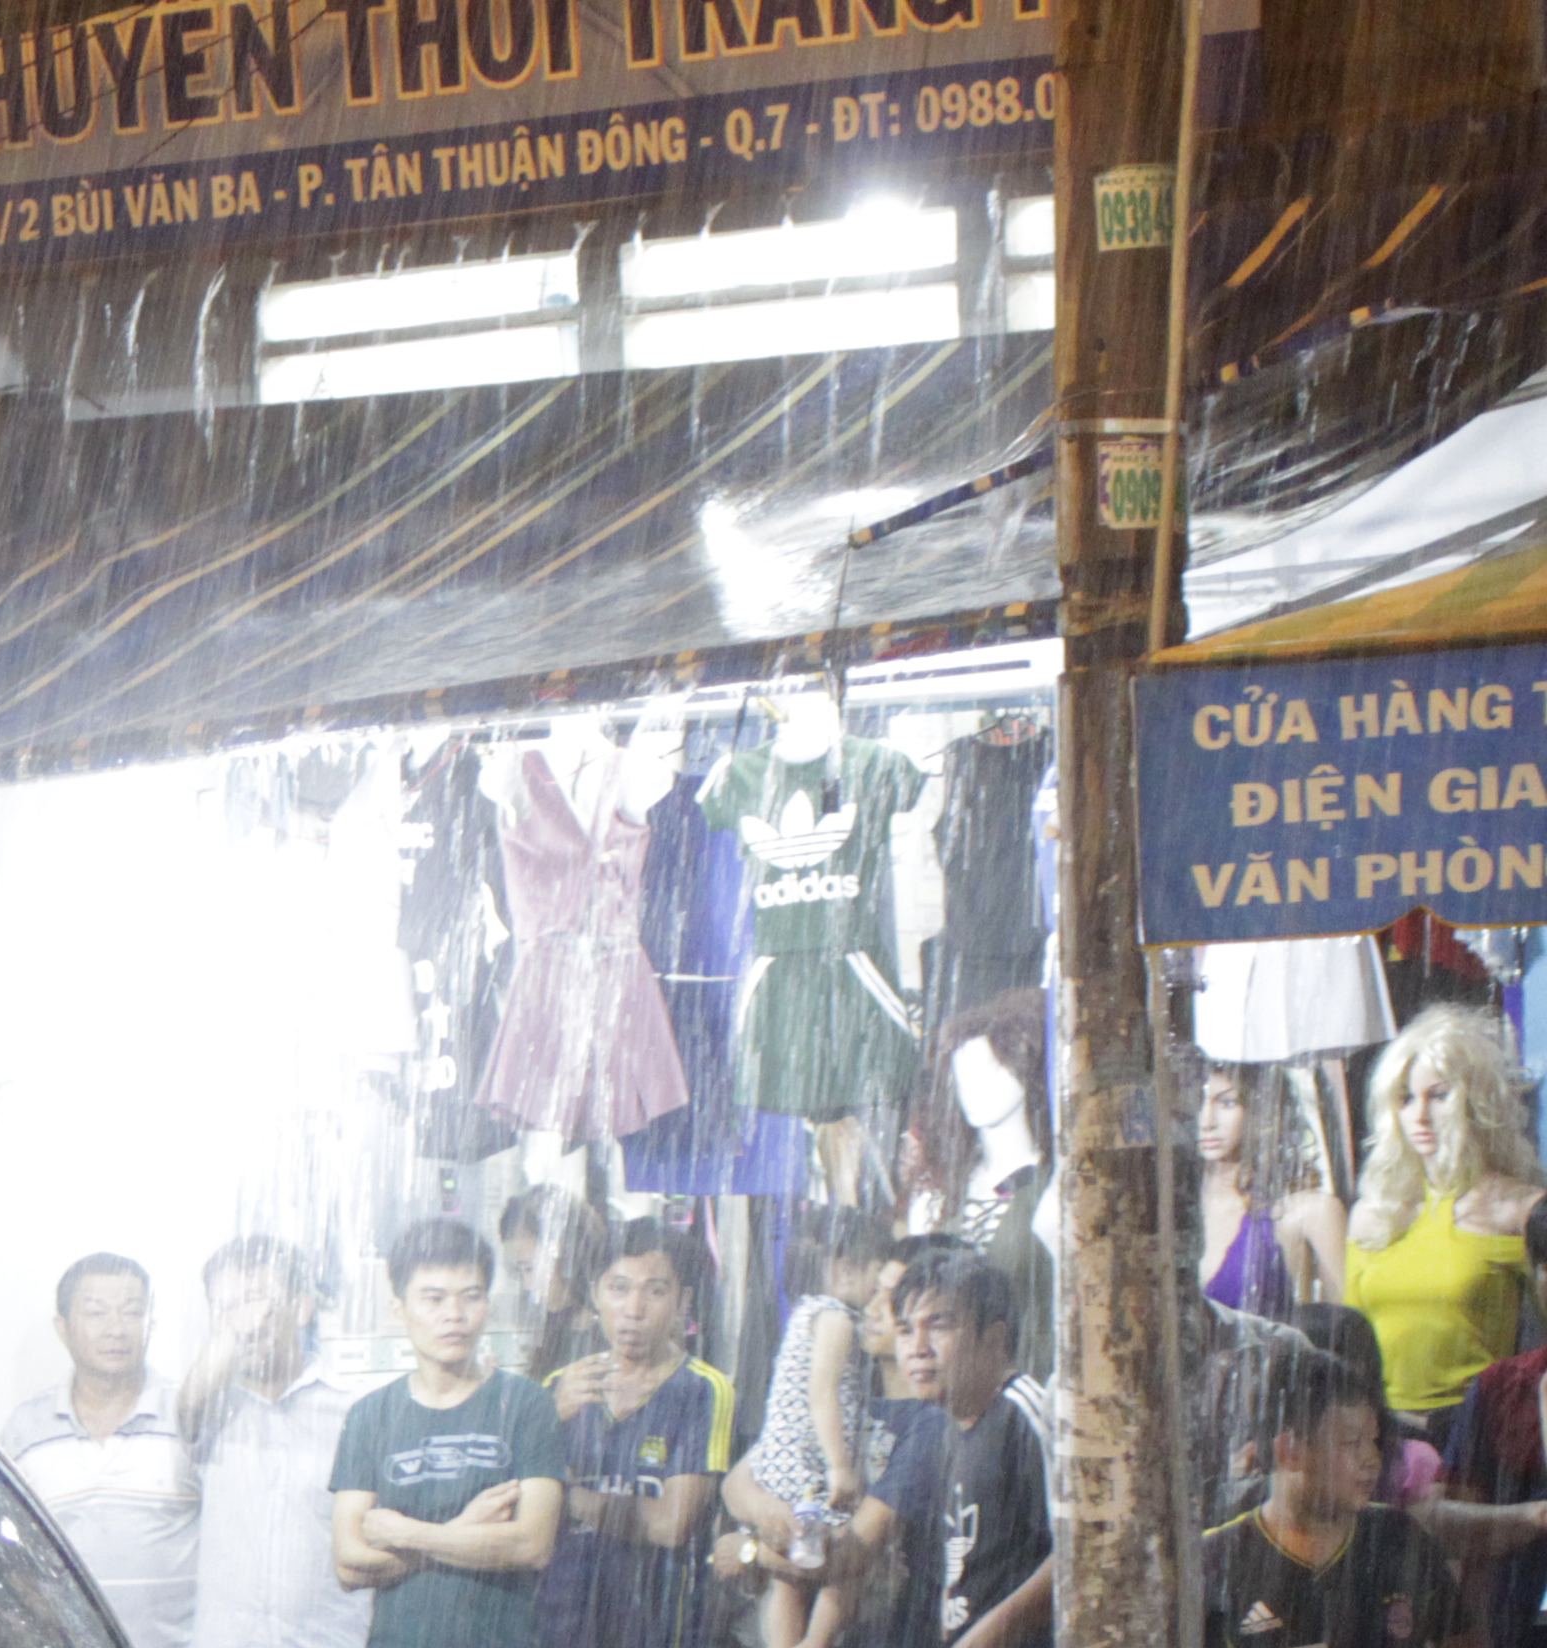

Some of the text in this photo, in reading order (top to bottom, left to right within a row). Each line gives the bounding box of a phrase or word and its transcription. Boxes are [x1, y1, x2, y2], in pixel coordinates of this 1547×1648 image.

[52, 182, 113, 237] BÙI
[124, 174, 199, 229] VĂN
[210, 171, 261, 216] BA
[298, 164, 335, 208] P.
[345, 143, 422, 203] TÂN
[433, 127, 565, 192] THUẬN
[577, 114, 687, 176] ĐÔNG
[724, 104, 791, 162] Q.7
[834, 92, 900, 143] ĐT:
[1193, 684, 1319, 751] CỬA
[1339, 679, 1514, 741] HÀNG
[1230, 762, 1547, 830] ĐIỆN GIA
[753, 870, 860, 909] adidas
[1192, 836, 1547, 908] VĂN PHÒN
